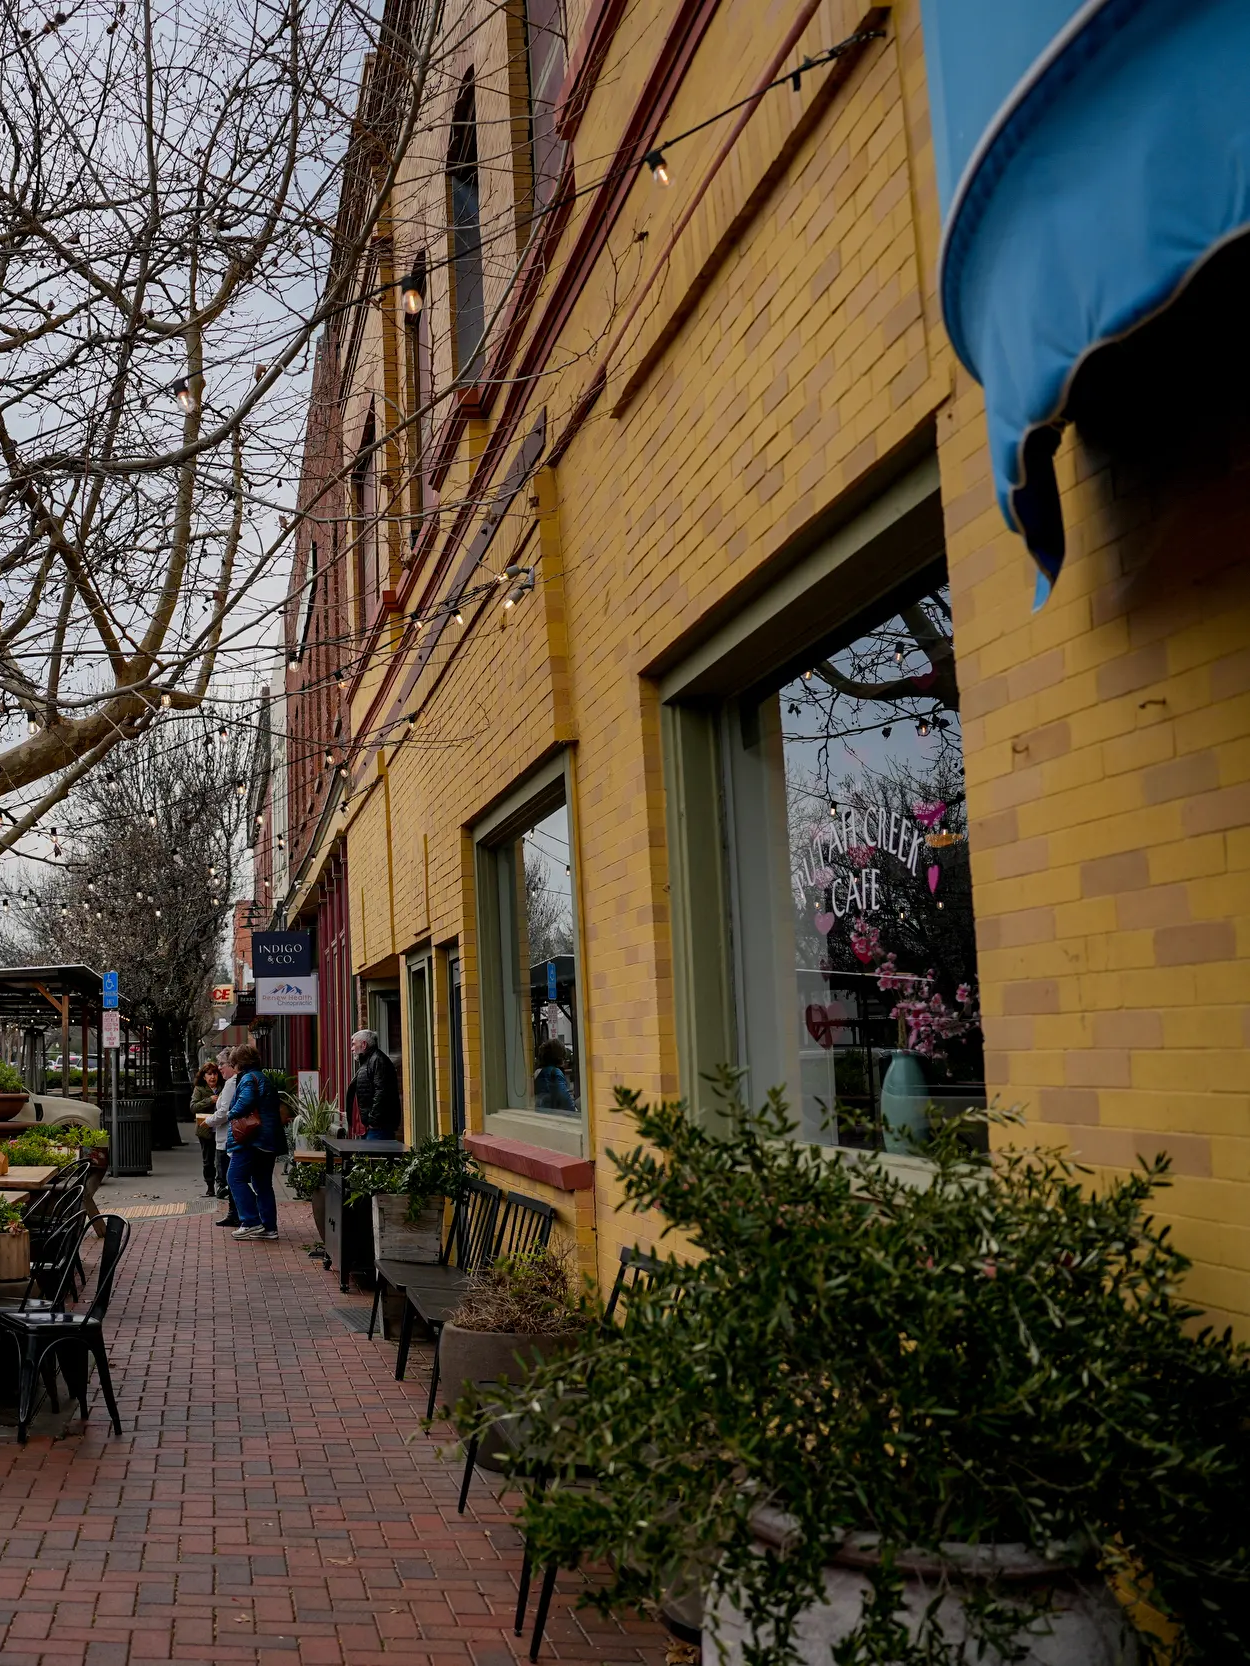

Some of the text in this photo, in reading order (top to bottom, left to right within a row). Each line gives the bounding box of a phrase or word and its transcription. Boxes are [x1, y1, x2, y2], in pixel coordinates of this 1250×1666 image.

[795, 807, 924, 905] PUTAH CREEK
[832, 868, 881, 918] CAFE
[259, 943, 303, 954] INDIGO
[267, 955, 295, 964] & CO.
[210, 988, 231, 1000] CE
